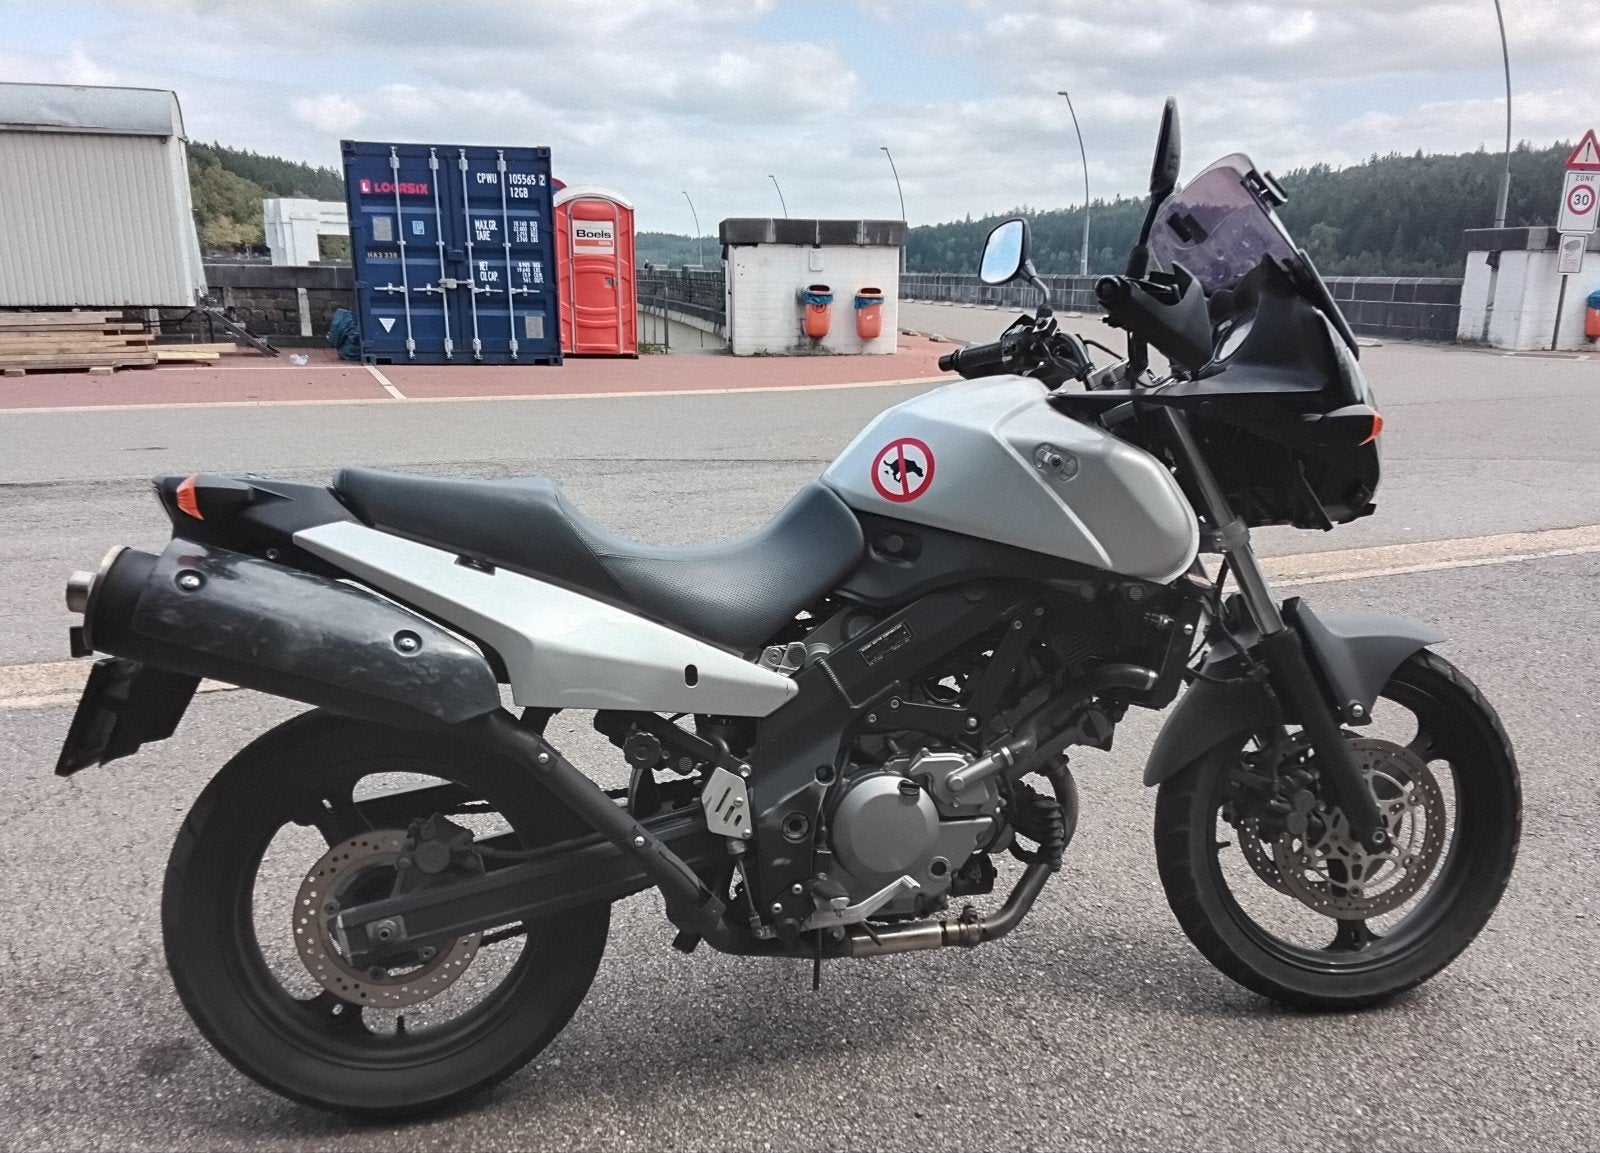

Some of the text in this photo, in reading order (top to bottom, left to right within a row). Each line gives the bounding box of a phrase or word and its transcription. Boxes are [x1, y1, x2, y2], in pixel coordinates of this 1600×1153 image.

[477, 172, 546, 186] CPWU 105565 2
[1575, 174, 1595, 182] ZONE
[509, 187, 529, 198] 12GB
[1573, 194, 1590, 206] 30
[576, 229, 612, 239] Boels
